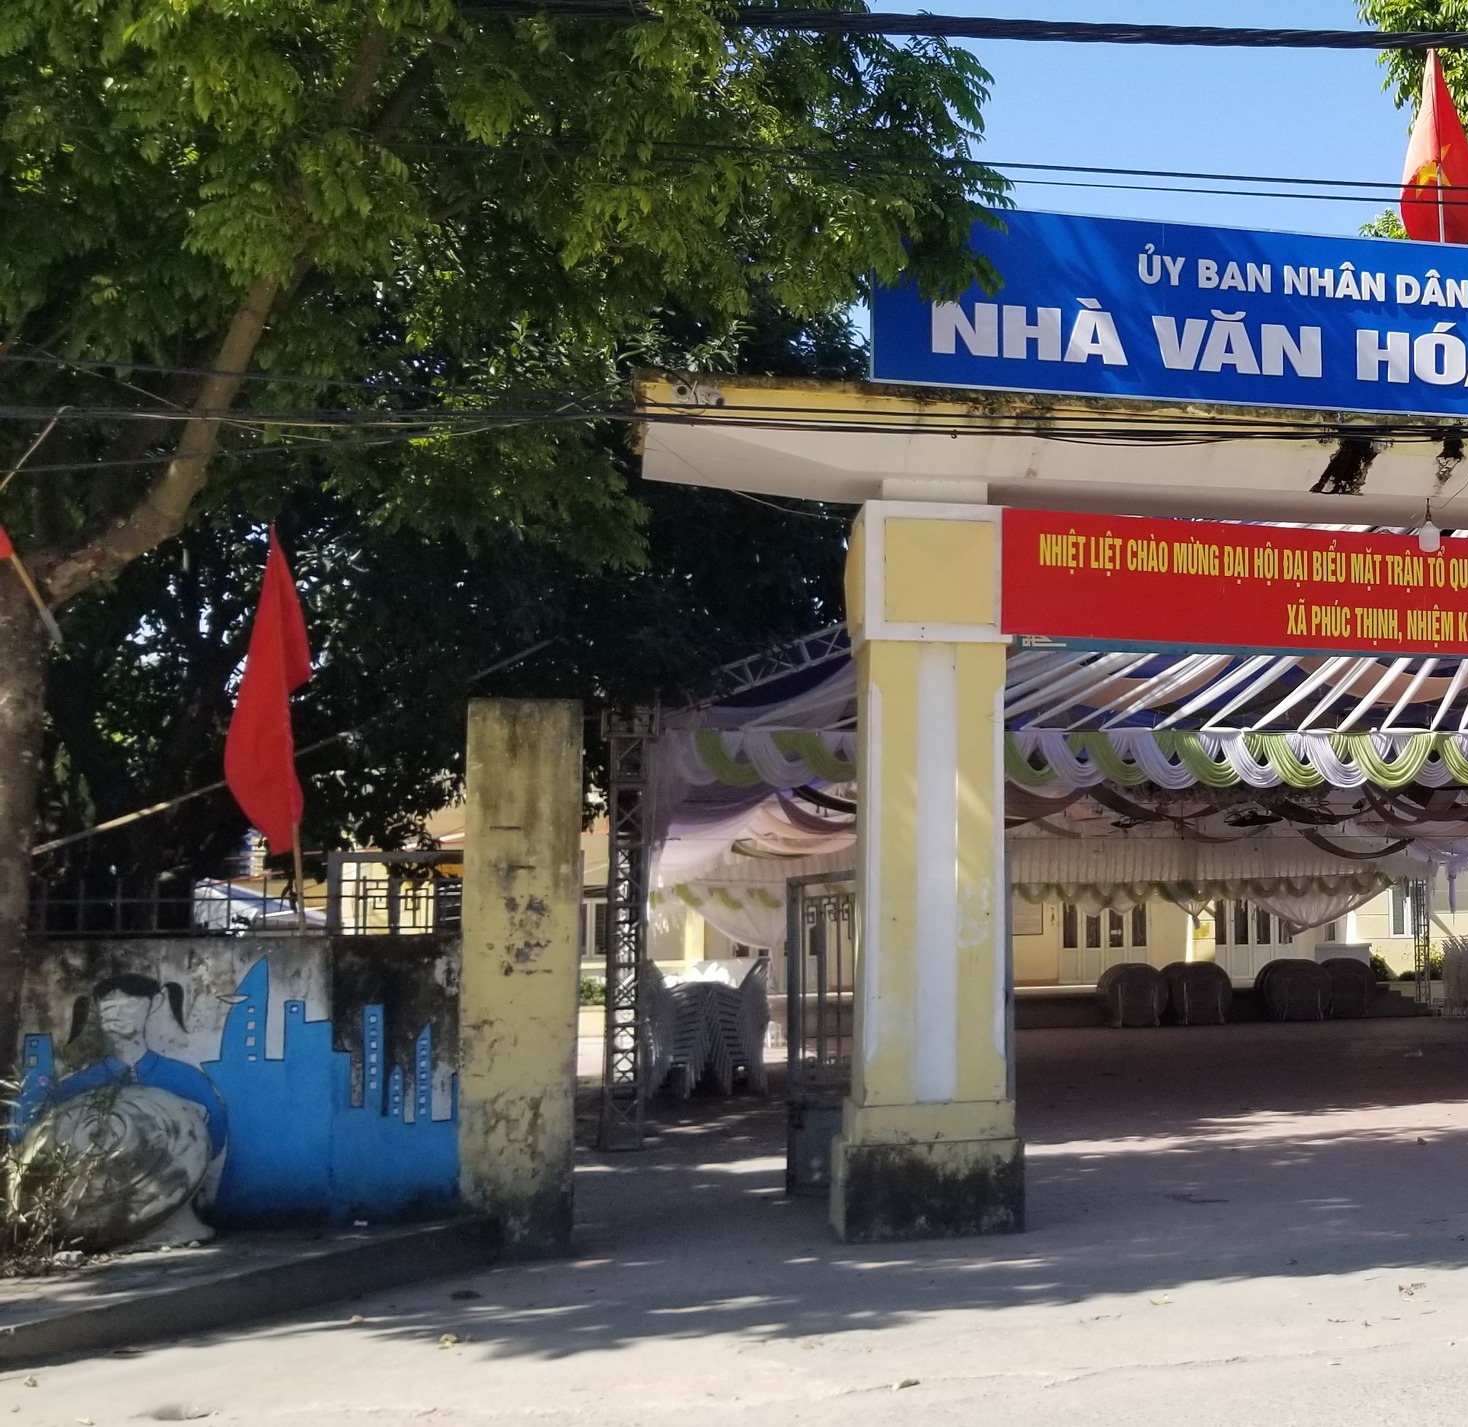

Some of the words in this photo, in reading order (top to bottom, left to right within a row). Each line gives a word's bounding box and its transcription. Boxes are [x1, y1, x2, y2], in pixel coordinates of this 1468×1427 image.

[1138, 243, 1186, 286] ỦY
[1198, 260, 1272, 294] BAN
[1284, 262, 1386, 301] NHÂN
[932, 297, 1129, 366] NHÀ
[1152, 309, 1322, 378] VĂN
[1039, 529, 1086, 574] NHIỆT
[1090, 531, 1122, 577] LIỆT
[1127, 534, 1168, 573] CHÀO
[1173, 536, 1219, 576] MỪNG
[1224, 546, 1249, 584] ĐẠI
[1254, 542, 1279, 586] HỘI
[1283, 549, 1308, 587] ĐẠI
[1313, 539, 1346, 583] BIỂU
[1350, 547, 1381, 591] MẶT
[1385, 550, 1424, 593] TRẬN
[1427, 545, 1445, 588] TỔ
[1287, 598, 1307, 636] XÃ
[1311, 601, 1351, 638] PHÚC
[1355, 608, 1402, 645] THỊNH,
[1407, 604, 1454, 647] NHIỆM
